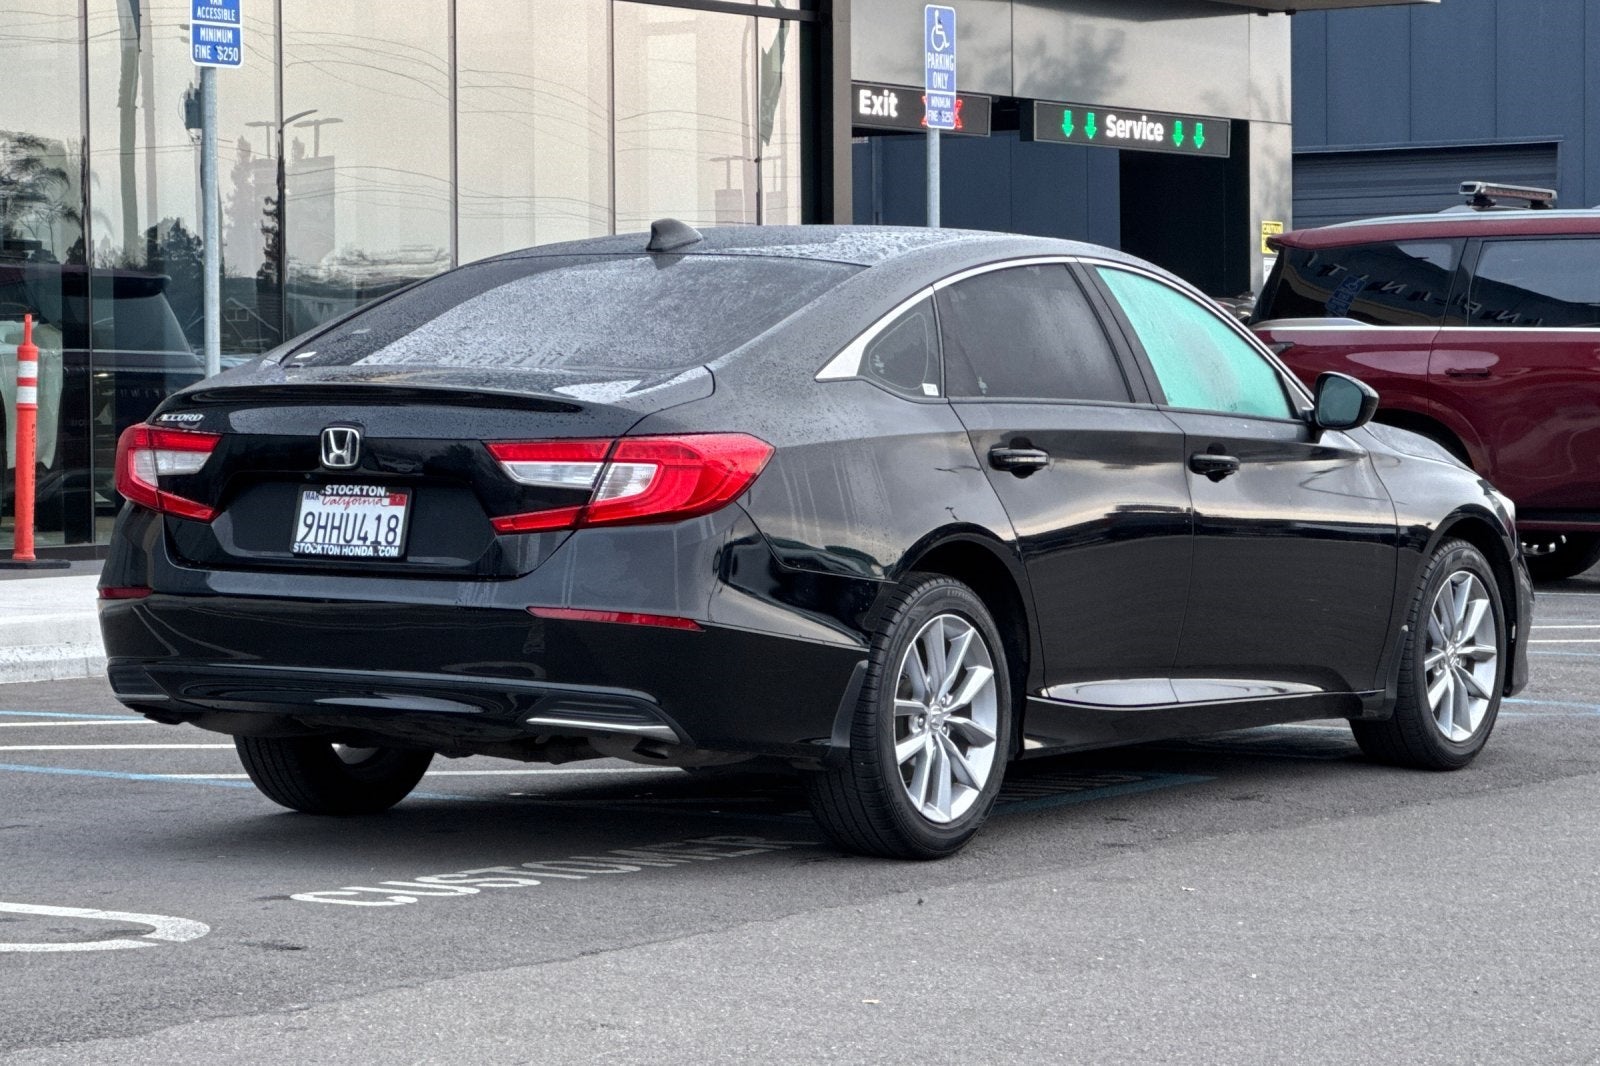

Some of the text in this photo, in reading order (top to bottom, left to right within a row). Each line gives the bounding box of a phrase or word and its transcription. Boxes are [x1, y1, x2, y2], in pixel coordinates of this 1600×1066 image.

[197, 6, 236, 21] ACCESSIBLE
[200, 27, 233, 43] MINIMUM
[195, 44, 239, 62] FINE $250
[928, 52, 954, 71] PARKING
[932, 72, 949, 89] ONLY
[859, 89, 898, 118] Exit
[931, 96, 951, 108] MINIMUM
[928, 109, 954, 123] FINE $250
[1105, 114, 1165, 142] Service
[158, 413, 205, 422] ACCORD
[325, 484, 386, 496] STOCKTON
[299, 511, 400, 546] 9HHU418
[293, 542, 340, 555] STOCKTON
[289, 835, 821, 906] CUSTOMER
